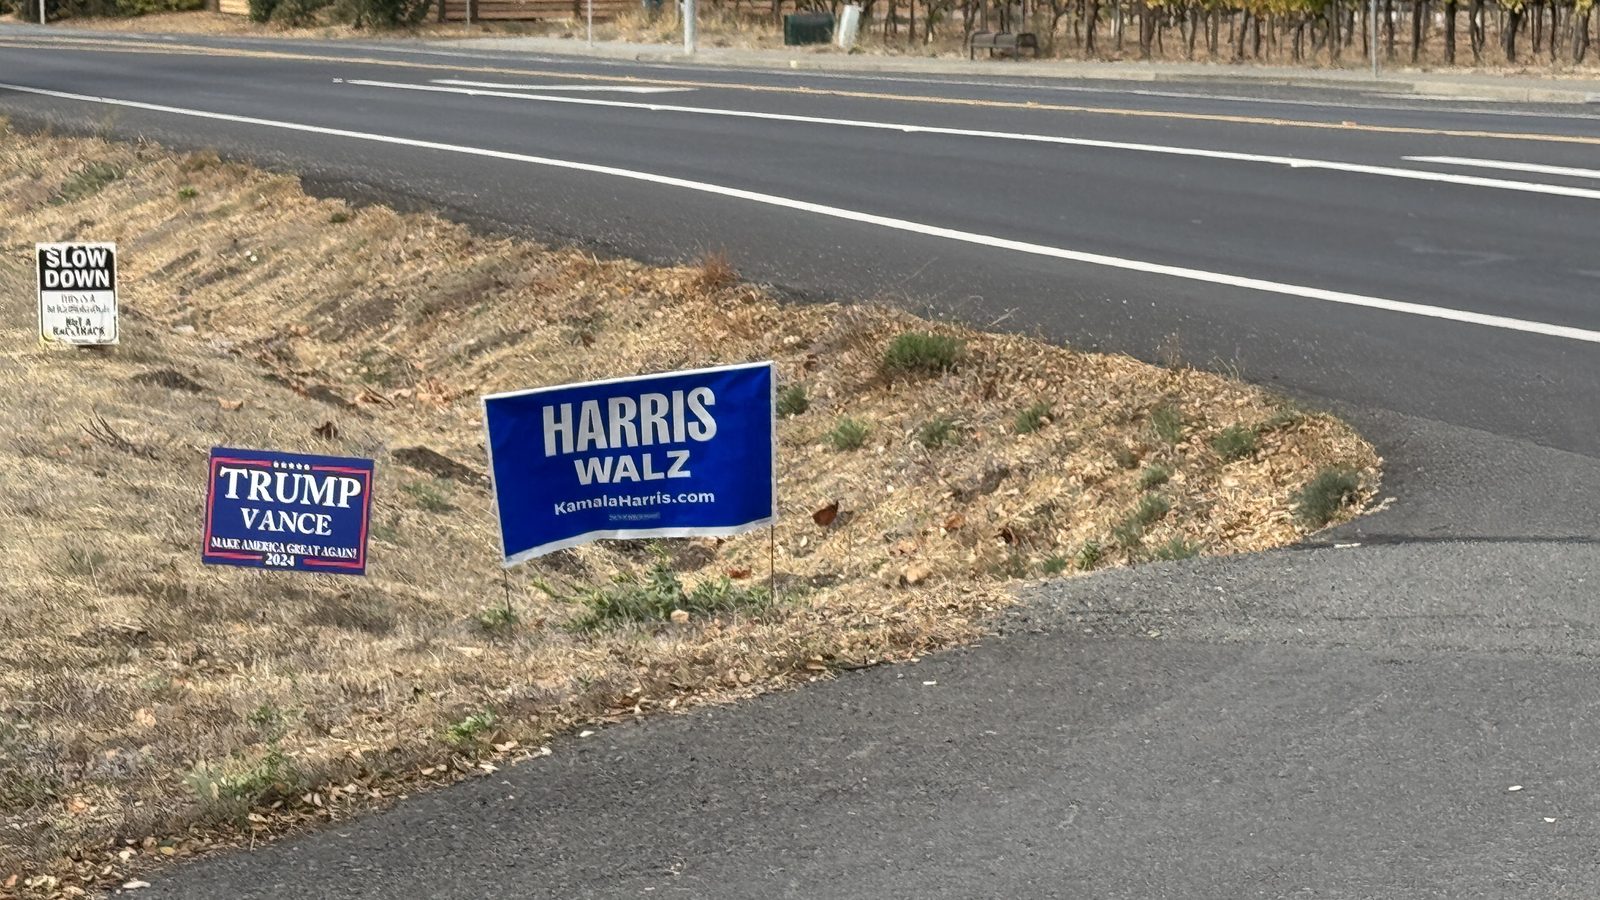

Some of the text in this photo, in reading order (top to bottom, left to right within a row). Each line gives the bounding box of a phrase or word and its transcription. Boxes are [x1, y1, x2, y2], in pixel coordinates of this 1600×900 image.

[46, 246, 107, 268] SLOW
[45, 269, 110, 288] DOWN
[542, 387, 717, 457] HARRIS
[574, 450, 691, 485] WALZ
[219, 466, 361, 508] TRUMP
[554, 491, 715, 515] KamalaHarris.com
[240, 507, 333, 536] VANCE
[211, 536, 358, 559] MAKE AMERICA GREAT AGAIN!
[265, 553, 295, 567] 2024
